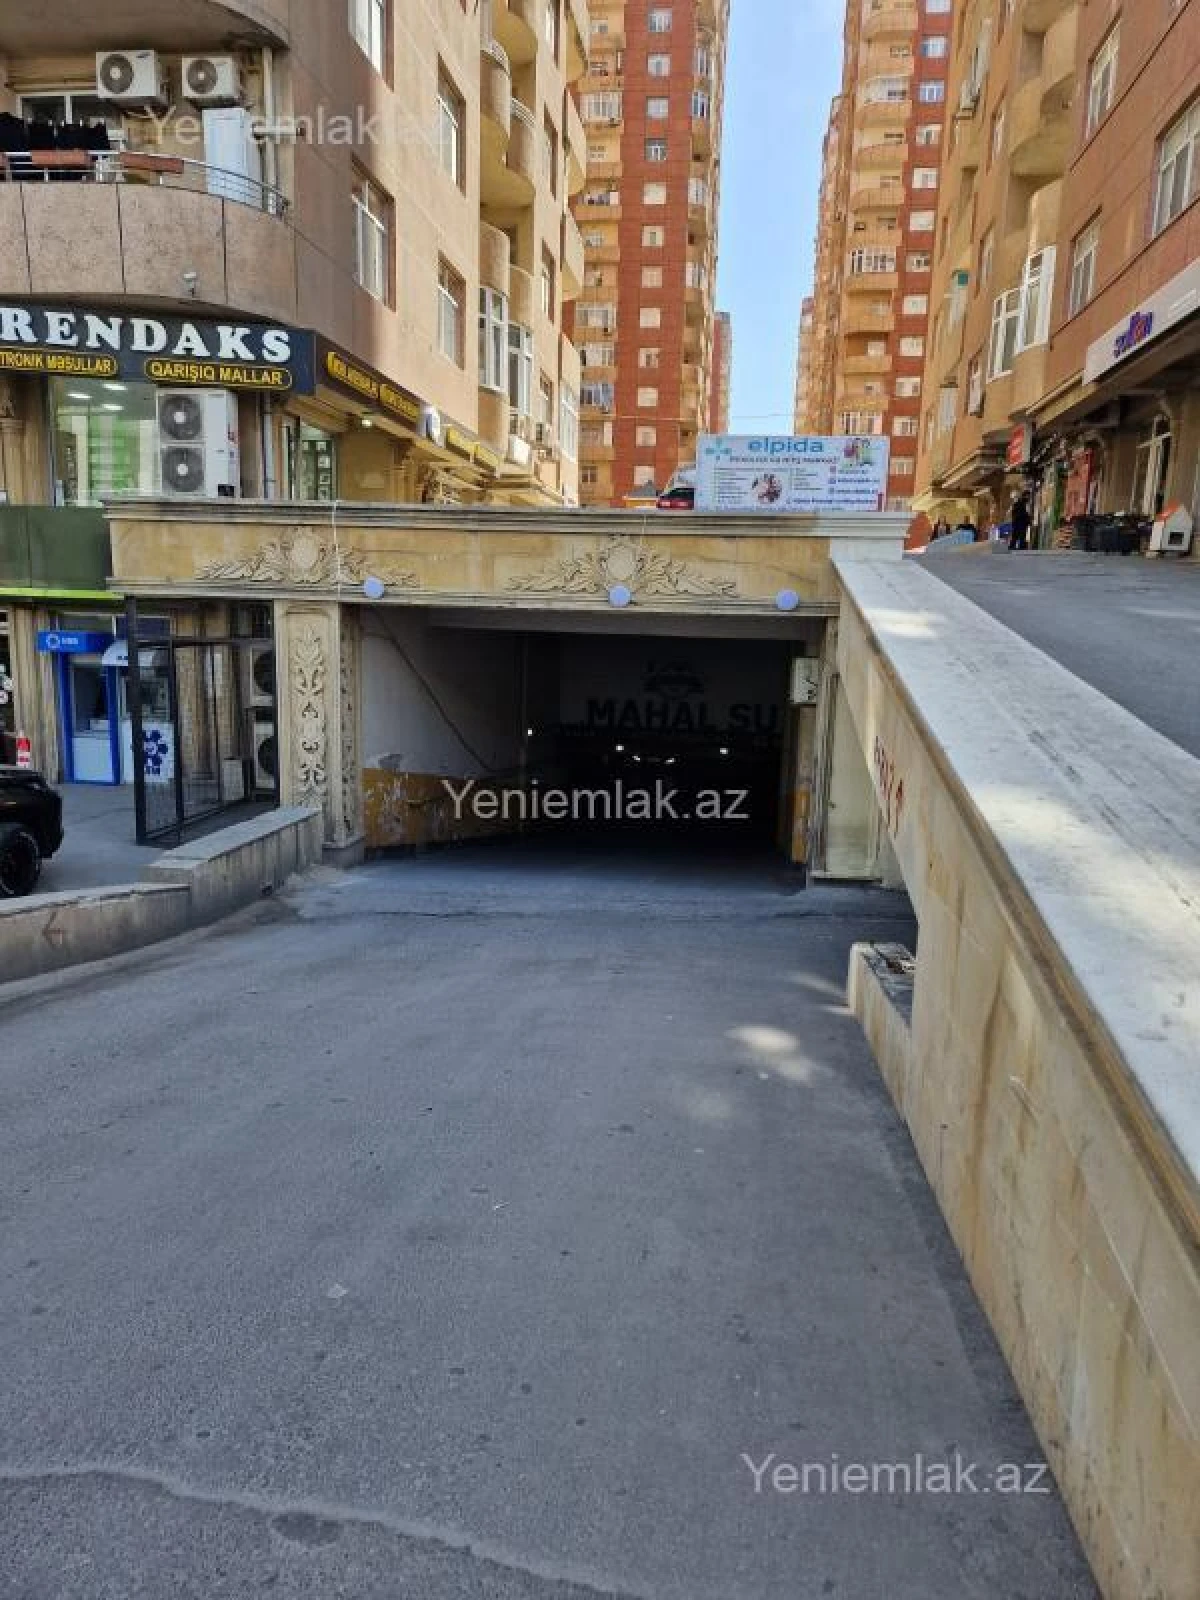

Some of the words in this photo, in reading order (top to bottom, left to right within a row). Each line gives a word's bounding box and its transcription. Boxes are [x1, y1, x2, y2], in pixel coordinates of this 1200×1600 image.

[219, 367, 283, 385] MALLAR
[747, 437, 824, 457] elpida
[586, 698, 722, 733] MAHAL
